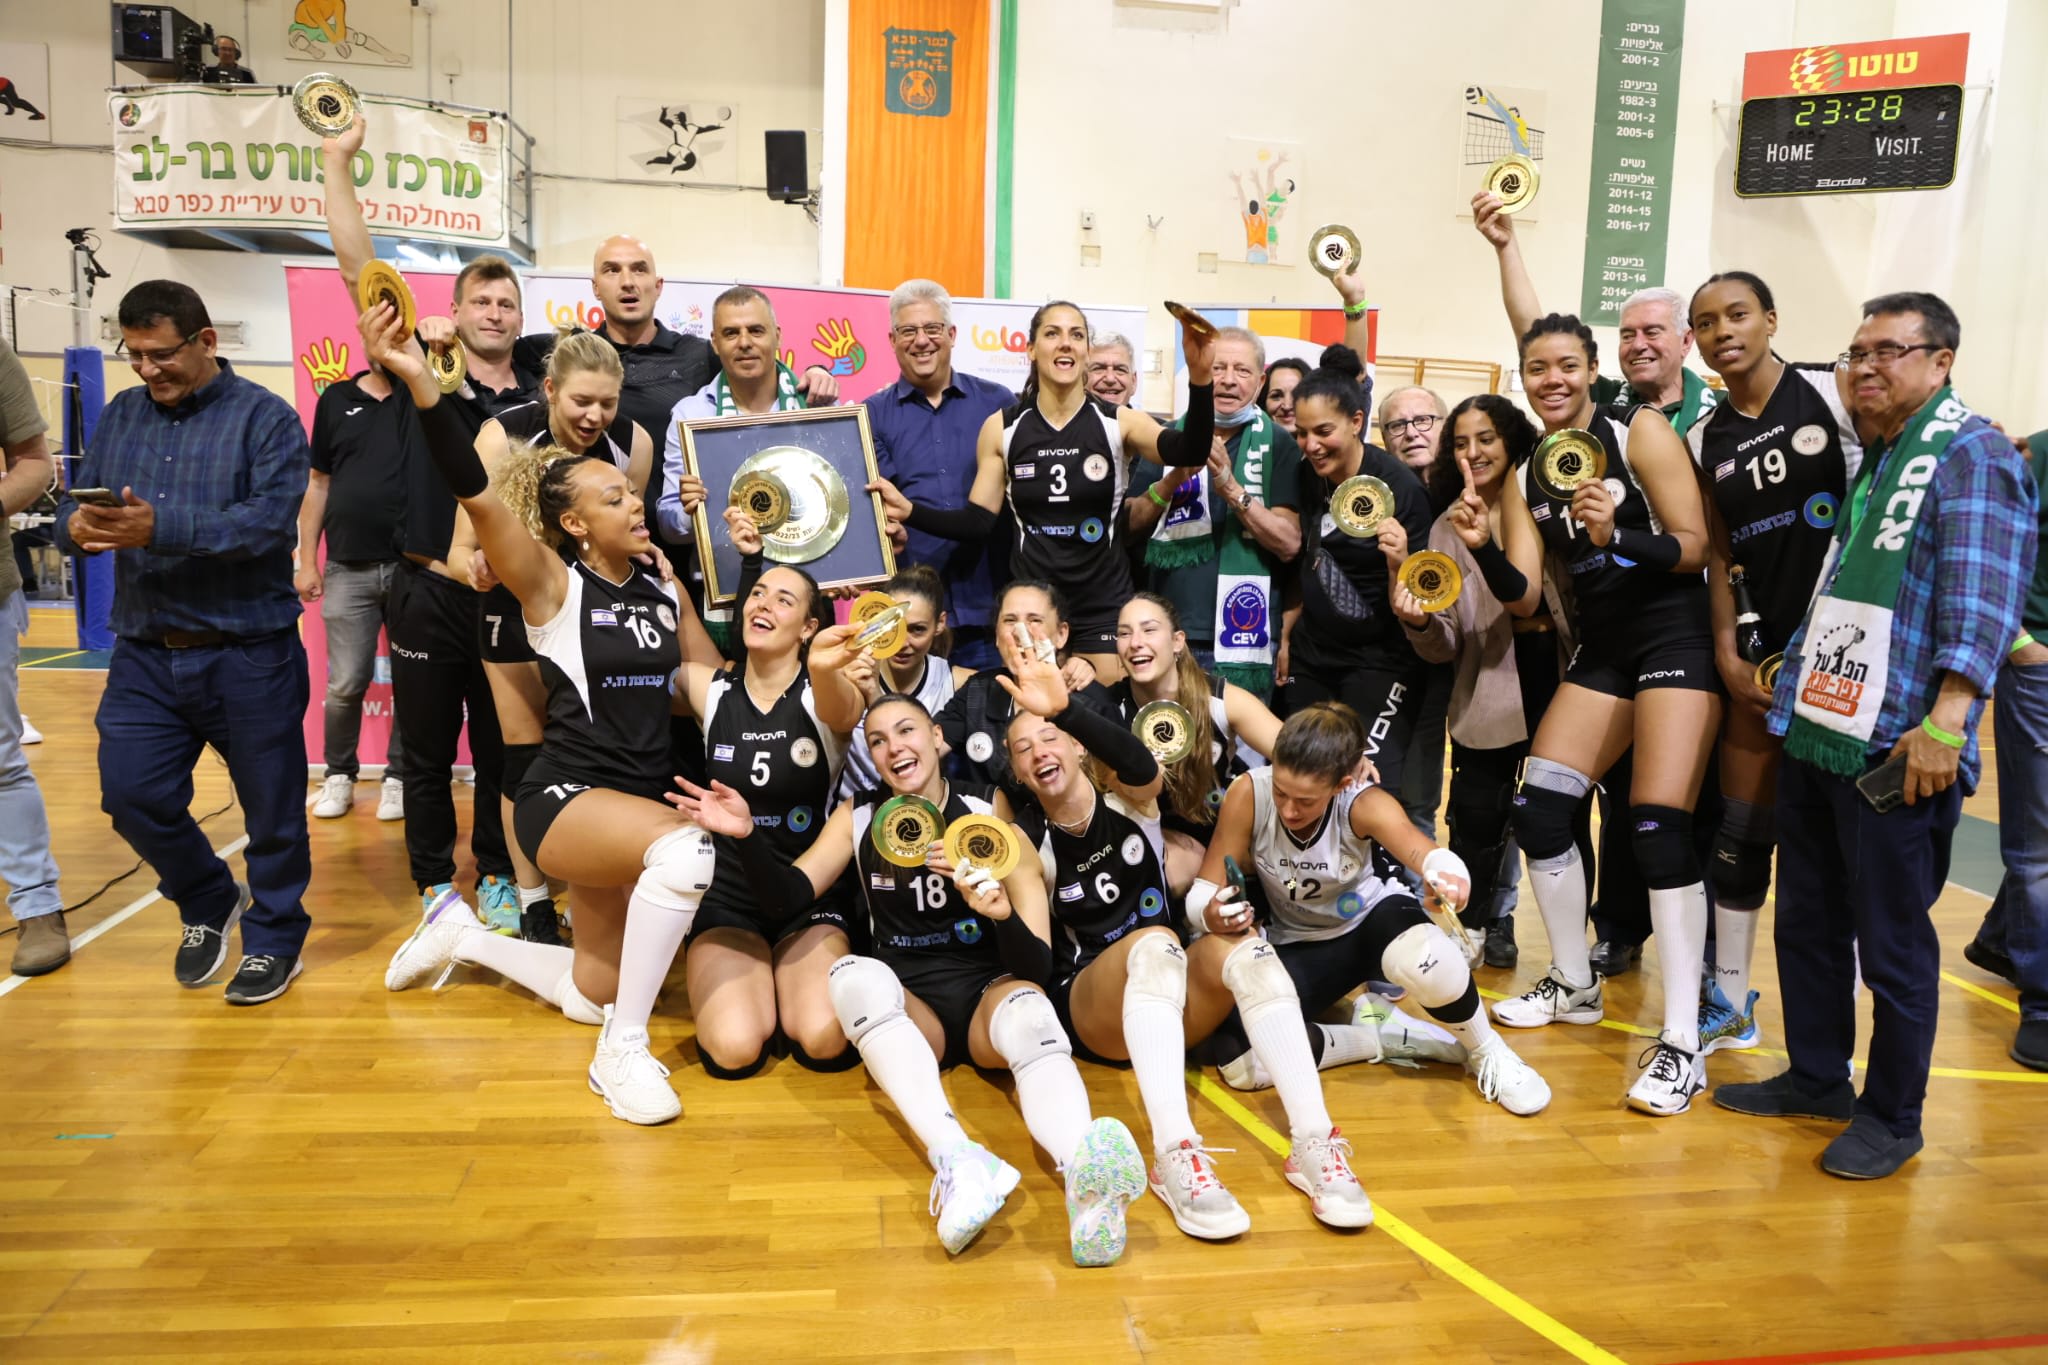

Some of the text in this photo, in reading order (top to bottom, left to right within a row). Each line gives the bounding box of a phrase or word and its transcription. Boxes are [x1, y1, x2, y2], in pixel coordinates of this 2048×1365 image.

[1626, 22, 1660, 34] גברים:
[1621, 54, 1660, 66] 2001-2
[1848, 51, 1919, 78] טוטו
[1620, 80, 1658, 91] גביעים:
[1619, 95, 1657, 108] 1982-3
[1795, 95, 1902, 126] 23:28
[1617, 111, 1656, 123] 2001-2
[1616, 127, 1654, 139] 2005-6
[131, 136, 237, 181] בר-לב
[1620, 158, 1646, 169] נשים
[385, 152, 483, 199] מרכז
[134, 194, 170, 214] סבא
[175, 194, 214, 213] כפר
[219, 194, 284, 214] עיריית
[1608, 188, 1653, 201] 2011-12
[386, 203, 481, 231] המחלקה
[1607, 204, 1652, 216] 2014-15
[1606, 219, 1650, 232] 2016-17
[1607, 255, 1644, 268] גביעים:
[1602, 271, 1647, 283] 2013-14
[1737, 424, 1785, 452] GIVOVA
[1037, 448, 1080, 457] GIVOVA
[1049, 463, 1068, 495] 3
[1745, 448, 1788, 491] 19
[1872, 454, 1938, 551] סבא
[485, 615, 502, 647] 7
[624, 614, 661, 649] 16
[1231, 632, 1259, 645] CEV
[749, 751, 771, 787] 5
[1280, 858, 1329, 871] GIVOVA
[908, 873, 948, 912] 18
[1094, 872, 1120, 905] 6
[1283, 877, 1322, 902] 12
